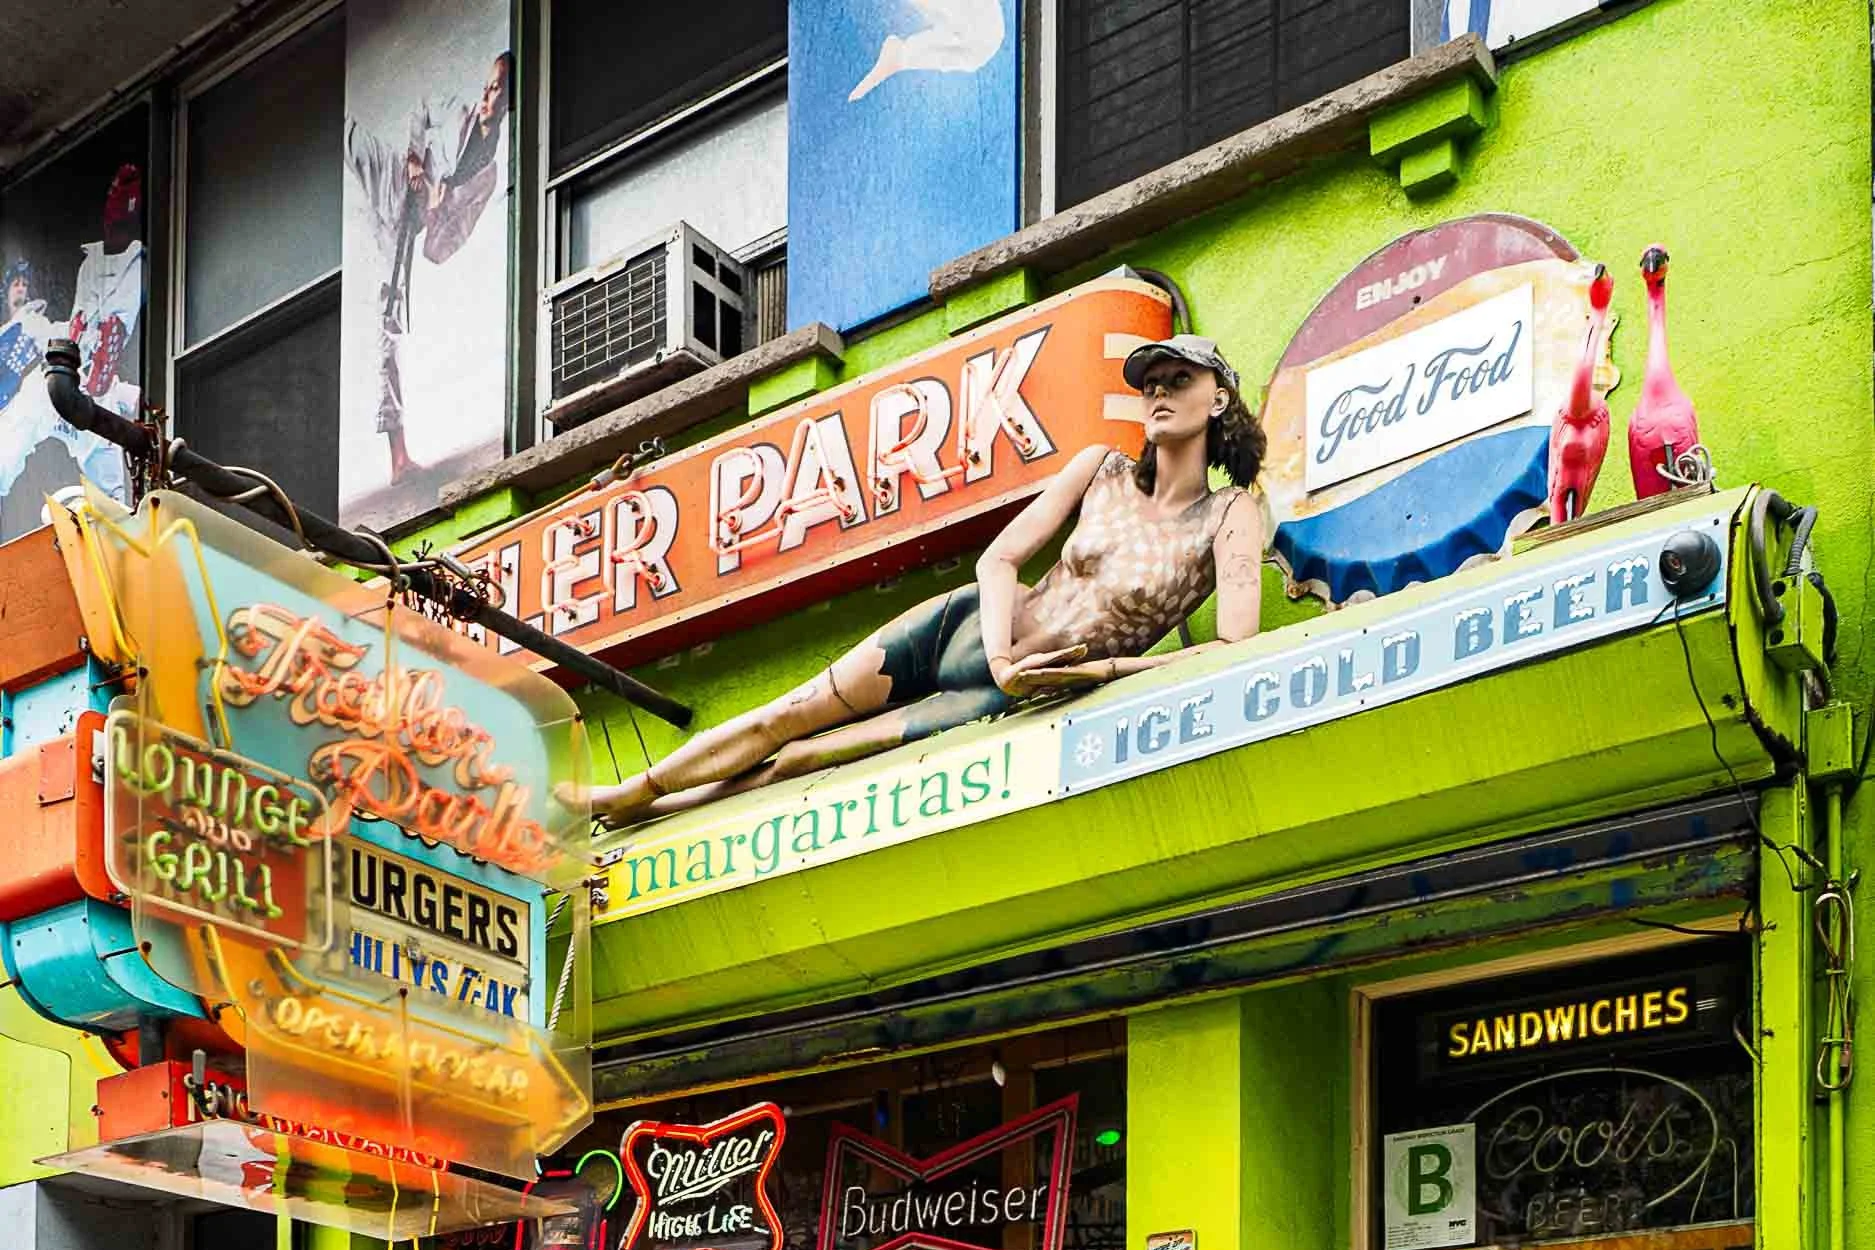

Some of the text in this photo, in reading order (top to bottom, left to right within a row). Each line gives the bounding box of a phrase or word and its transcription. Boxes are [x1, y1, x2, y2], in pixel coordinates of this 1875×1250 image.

[1355, 255, 1448, 311] ENJOY
[1316, 320, 1522, 464] Good Food
[462, 323, 1058, 656] LER PARK
[1115, 554, 1651, 763] ICE COLD BEER
[113, 727, 312, 847] LOUNGE
[626, 742, 1012, 900] margaritas!
[148, 831, 283, 918] GRILL
[1448, 988, 1688, 1057] SANDWICHES
[648, 1129, 774, 1198] Miller
[1408, 1144, 1452, 1216] B
[1484, 1103, 1680, 1179] Coors
[841, 1180, 1049, 1238] Budweiser
